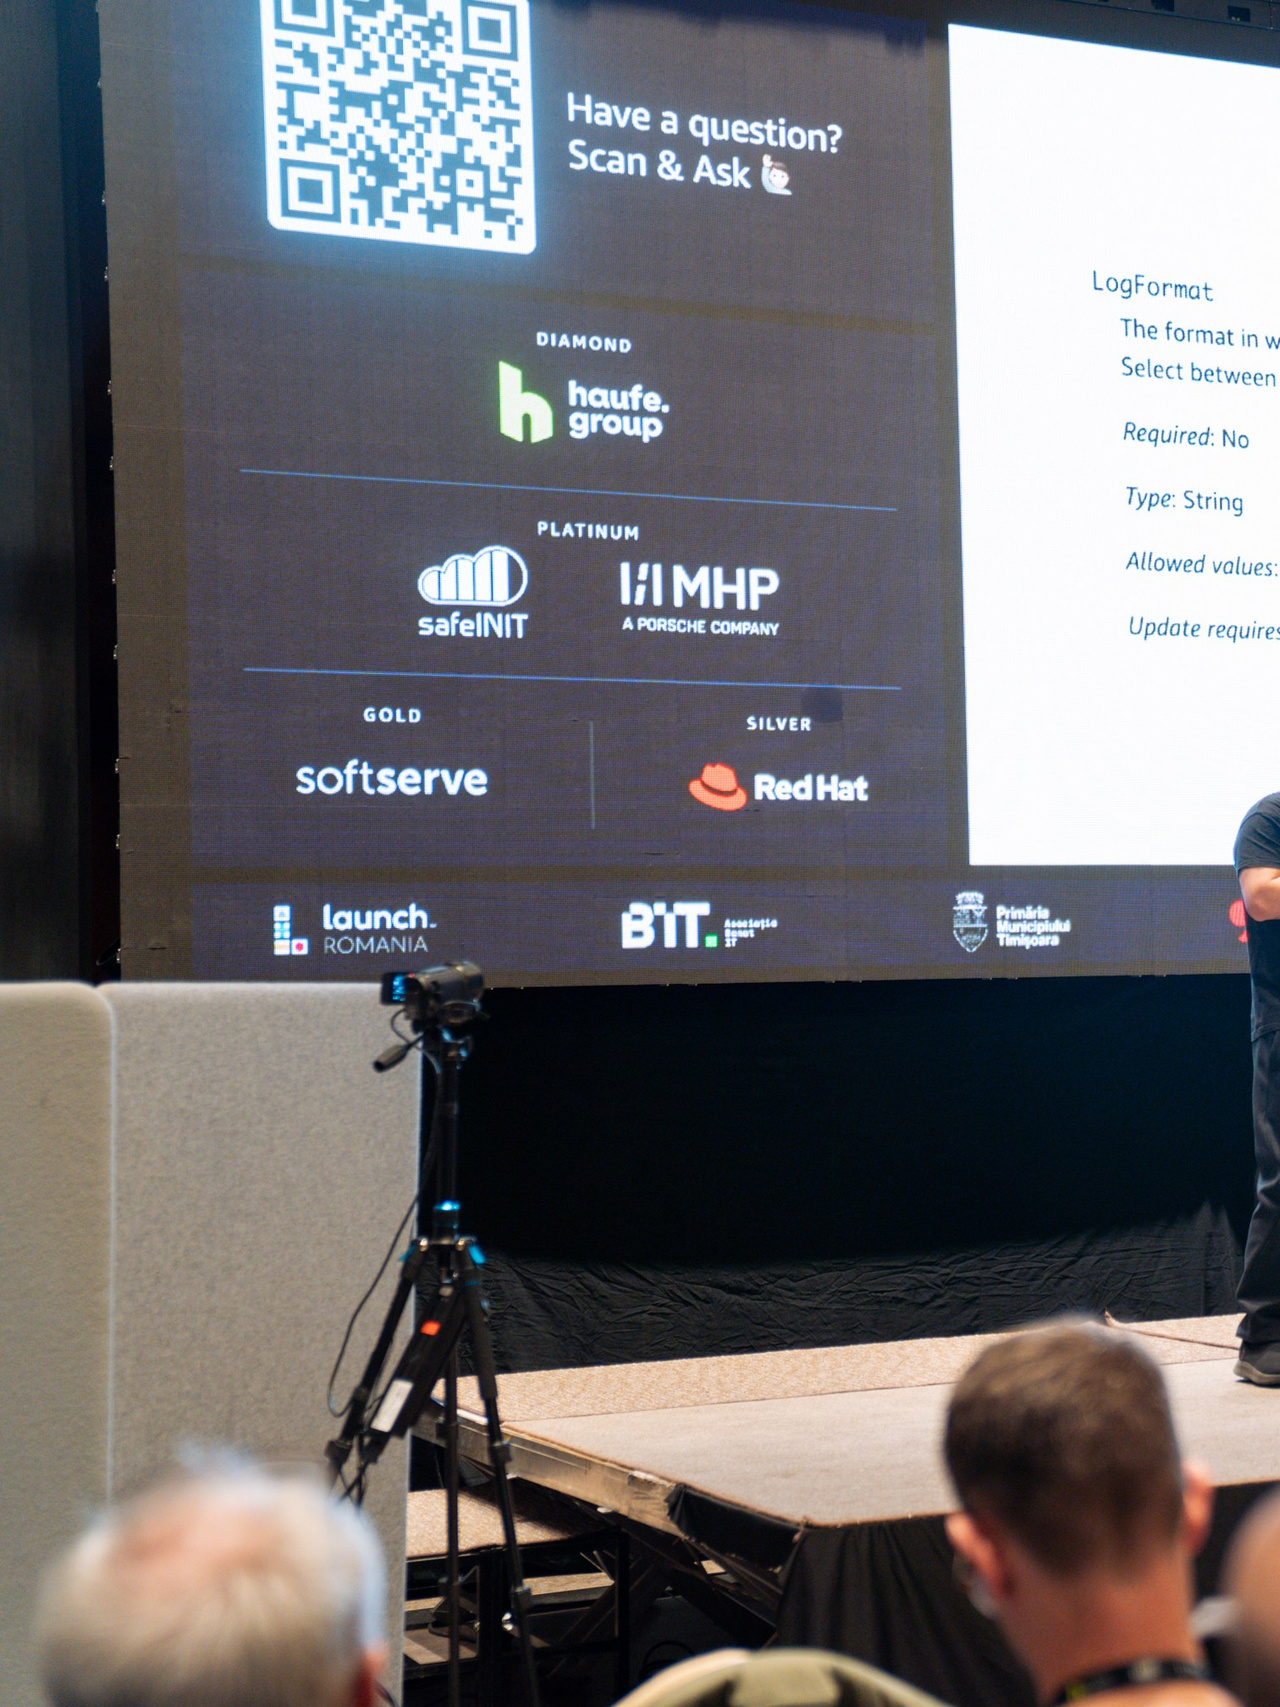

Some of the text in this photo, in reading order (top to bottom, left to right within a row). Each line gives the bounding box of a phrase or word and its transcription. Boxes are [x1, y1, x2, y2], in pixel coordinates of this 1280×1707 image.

[567, 92, 843, 154] Have a question?
[568, 139, 752, 189] Scan & Ask
[1092, 270, 1214, 302] LogFormat
[536, 331, 633, 353] DIAMOND
[1120, 318, 1158, 340] The
[1166, 321, 1234, 347] format
[1241, 329, 1259, 348] in
[1121, 357, 1183, 381] Select
[1190, 362, 1276, 387] between
[568, 379, 670, 413] haufe.
[569, 411, 664, 444] group
[1123, 421, 1250, 449] Required: No
[1125, 486, 1244, 517] Type: String
[537, 520, 639, 541] PLATINUM
[1125, 551, 1205, 575] Allowed
[1212, 556, 1278, 577] values:
[673, 564, 780, 611] MHP
[418, 612, 529, 640] safeINIT
[622, 616, 780, 636] A PORSCHE COMPANY
[1129, 616, 1200, 640] Update
[363, 707, 422, 724] GOLD
[746, 715, 812, 732] SILVER
[296, 759, 489, 797] softserve
[753, 773, 868, 801] Red Hat
[996, 904, 1050, 920] Primăria
[996, 918, 1071, 935] Municipiului
[324, 935, 429, 954] ROMANIA
